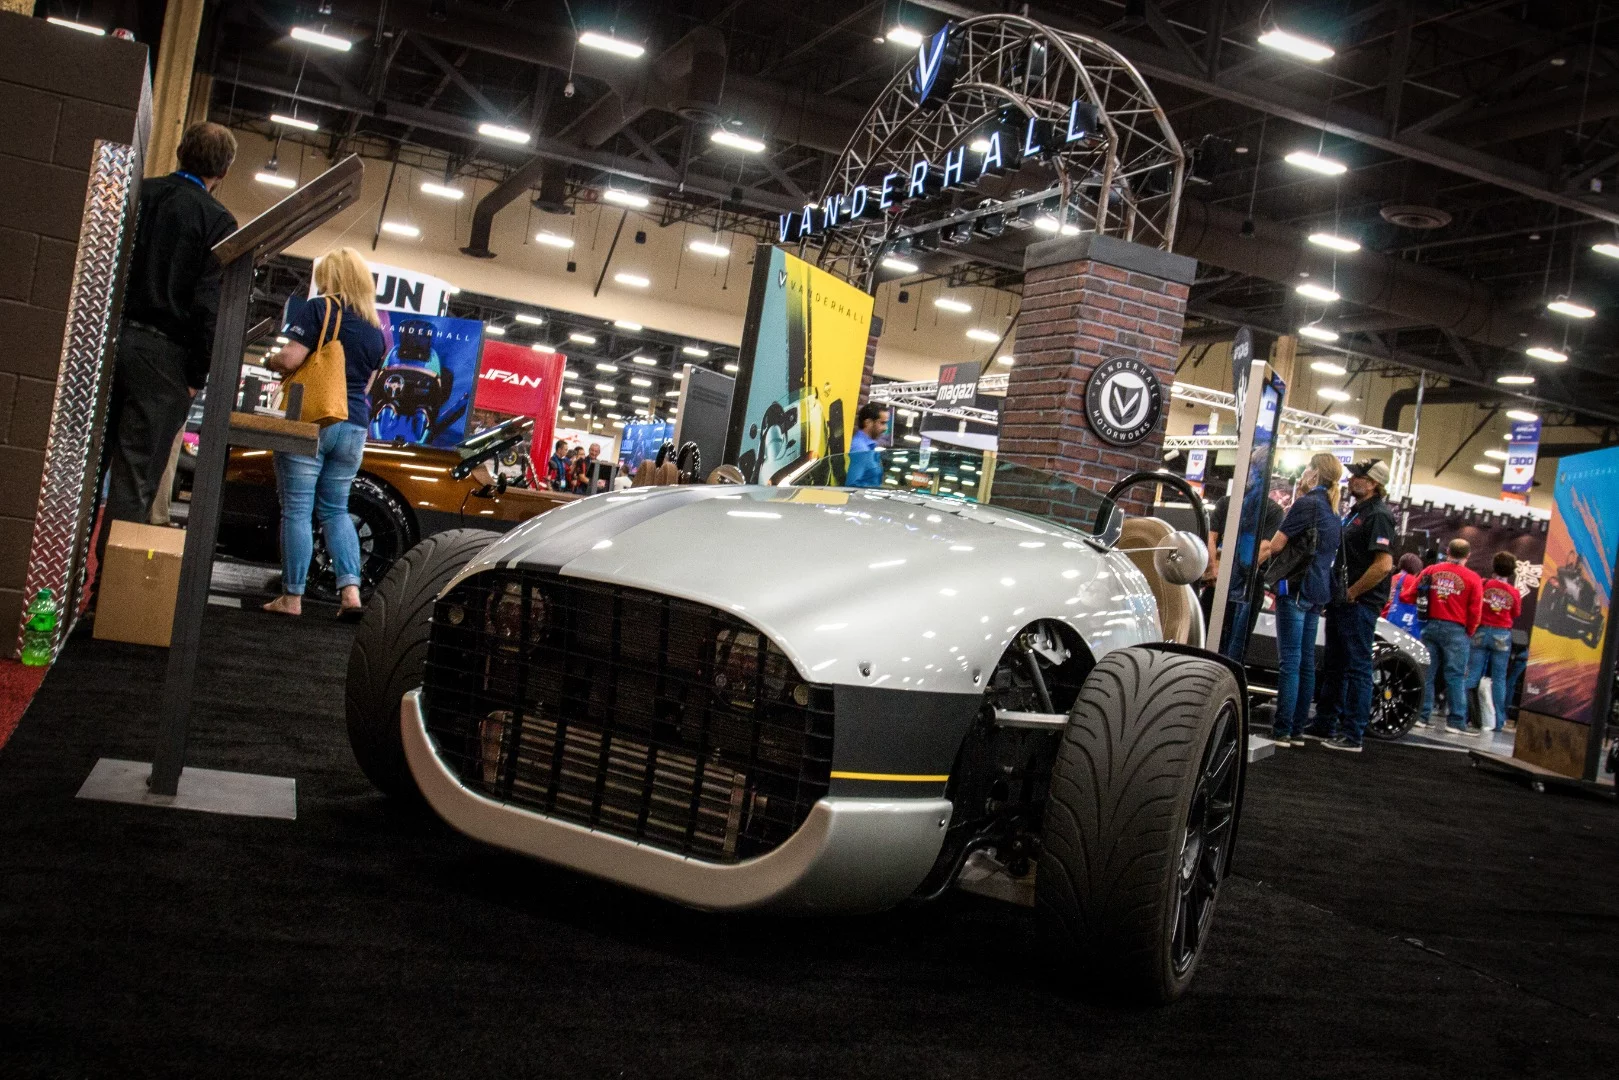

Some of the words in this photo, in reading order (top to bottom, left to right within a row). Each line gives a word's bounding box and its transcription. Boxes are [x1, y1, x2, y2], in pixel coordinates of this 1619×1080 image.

[778, 100, 1085, 243] VANDERHALL
[790, 280, 865, 325] VANDERHALL
[381, 323, 470, 342] VANDERHALL
[1095, 360, 1159, 398] VANDERHALL
[1093, 409, 1151, 441] MOTORWORKS
